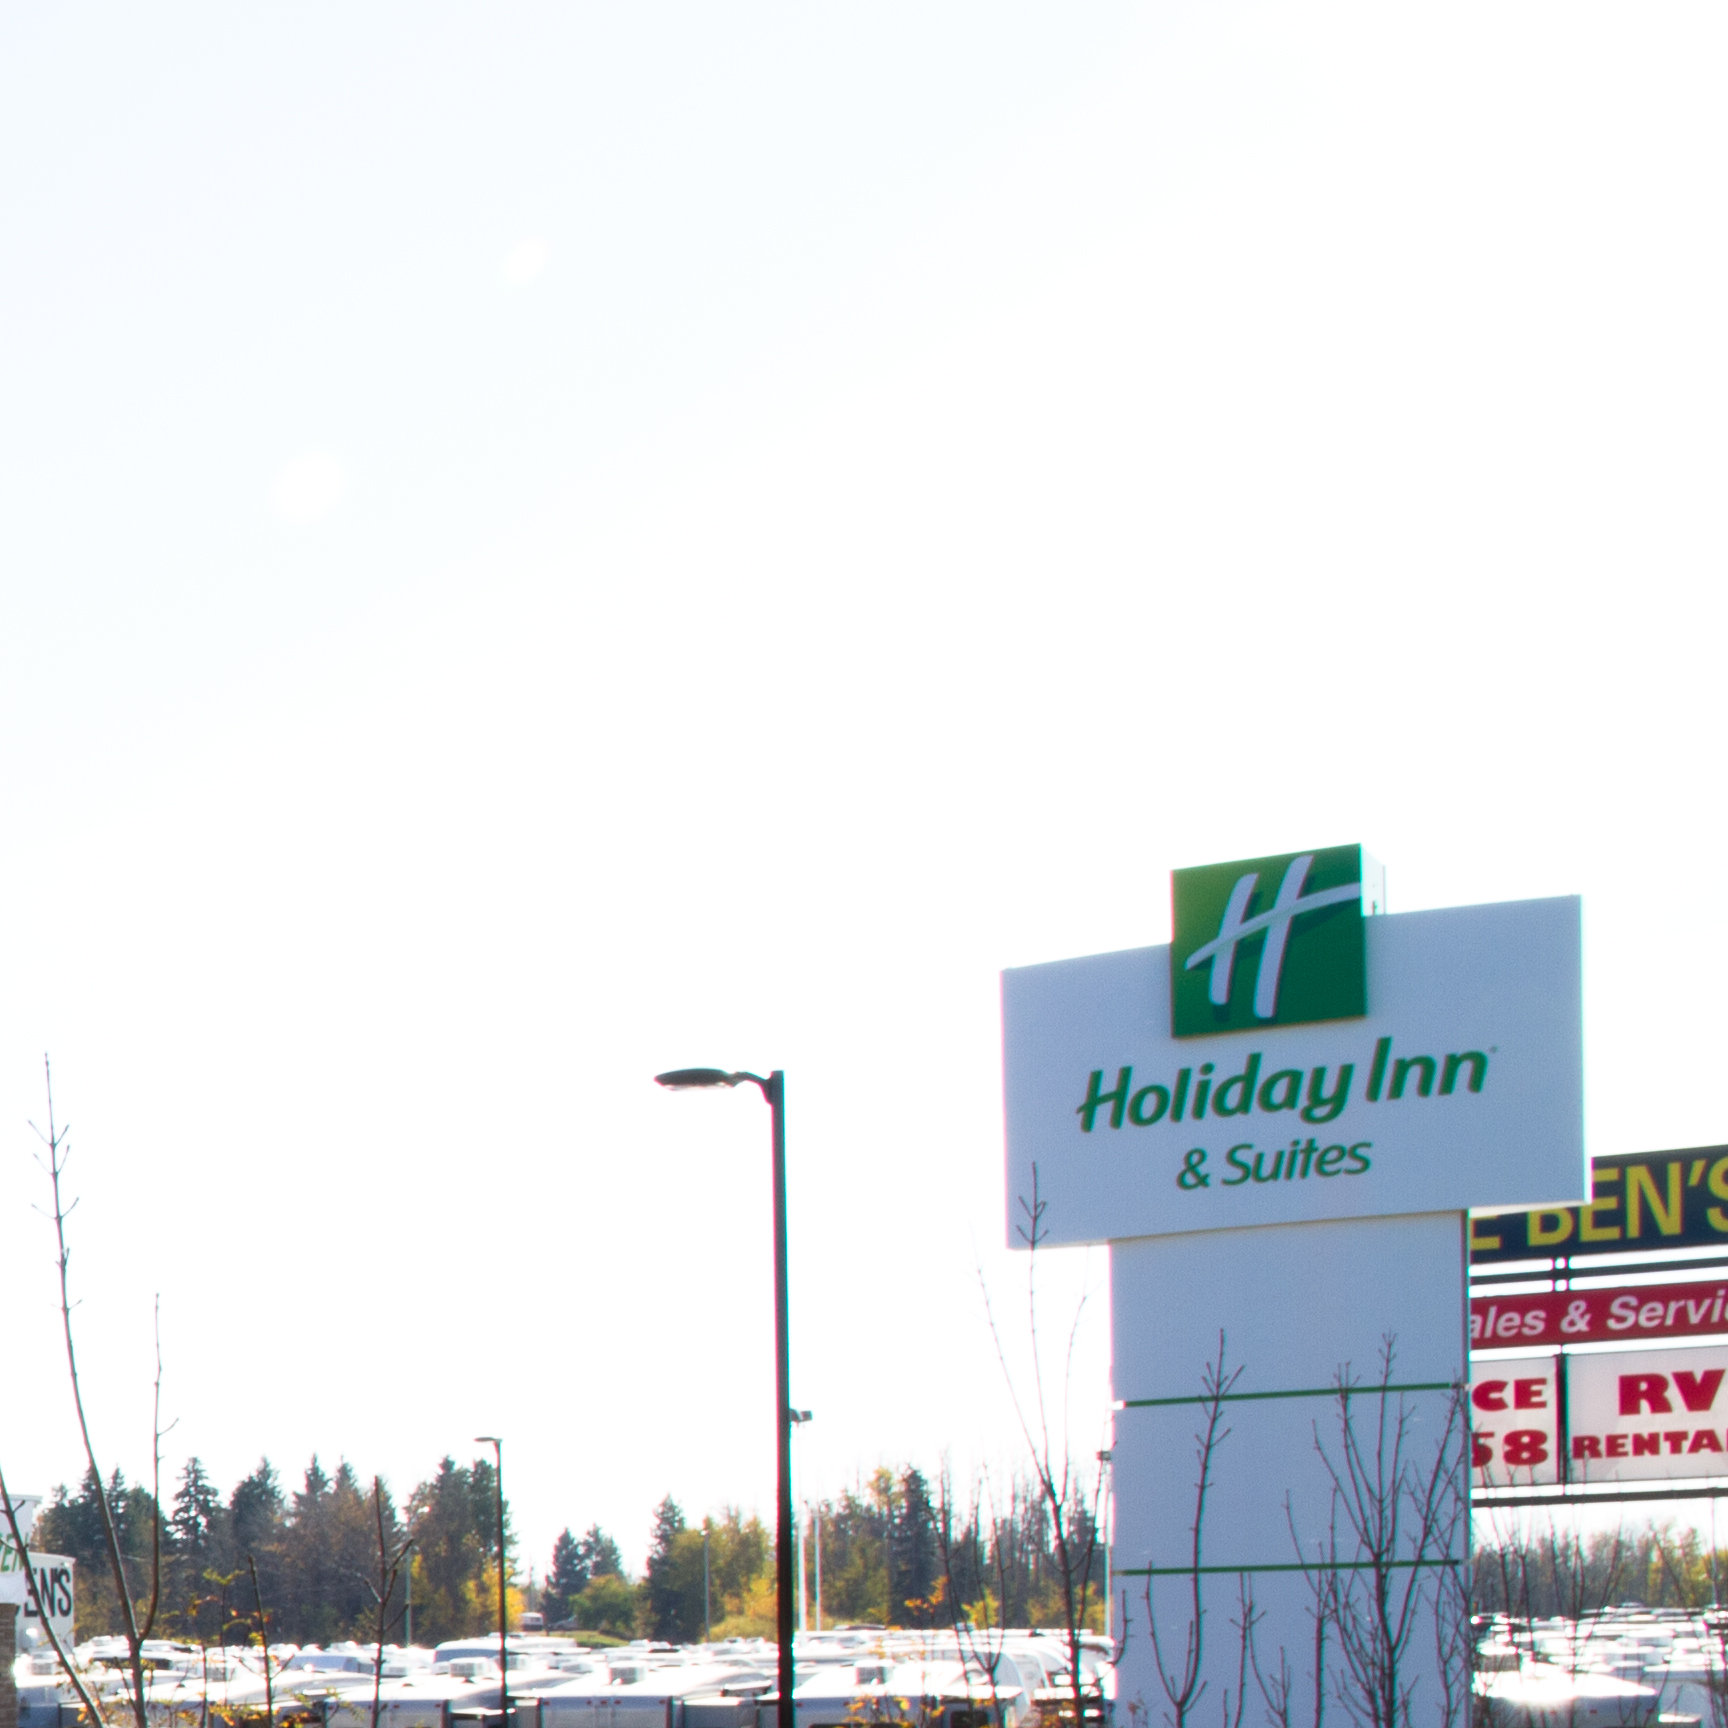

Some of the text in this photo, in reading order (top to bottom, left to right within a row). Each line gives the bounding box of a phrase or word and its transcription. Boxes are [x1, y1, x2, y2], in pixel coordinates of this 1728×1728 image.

[1076, 1035, 1489, 1133] Holiday Inn
[1176, 1137, 1374, 1191] & Suites
[1559, 1298, 1592, 1334] &
[1605, 1288, 1728, 1331] Servi
[1617, 1368, 1727, 1417] RV
[1571, 1428, 1728, 1461] RENTA
